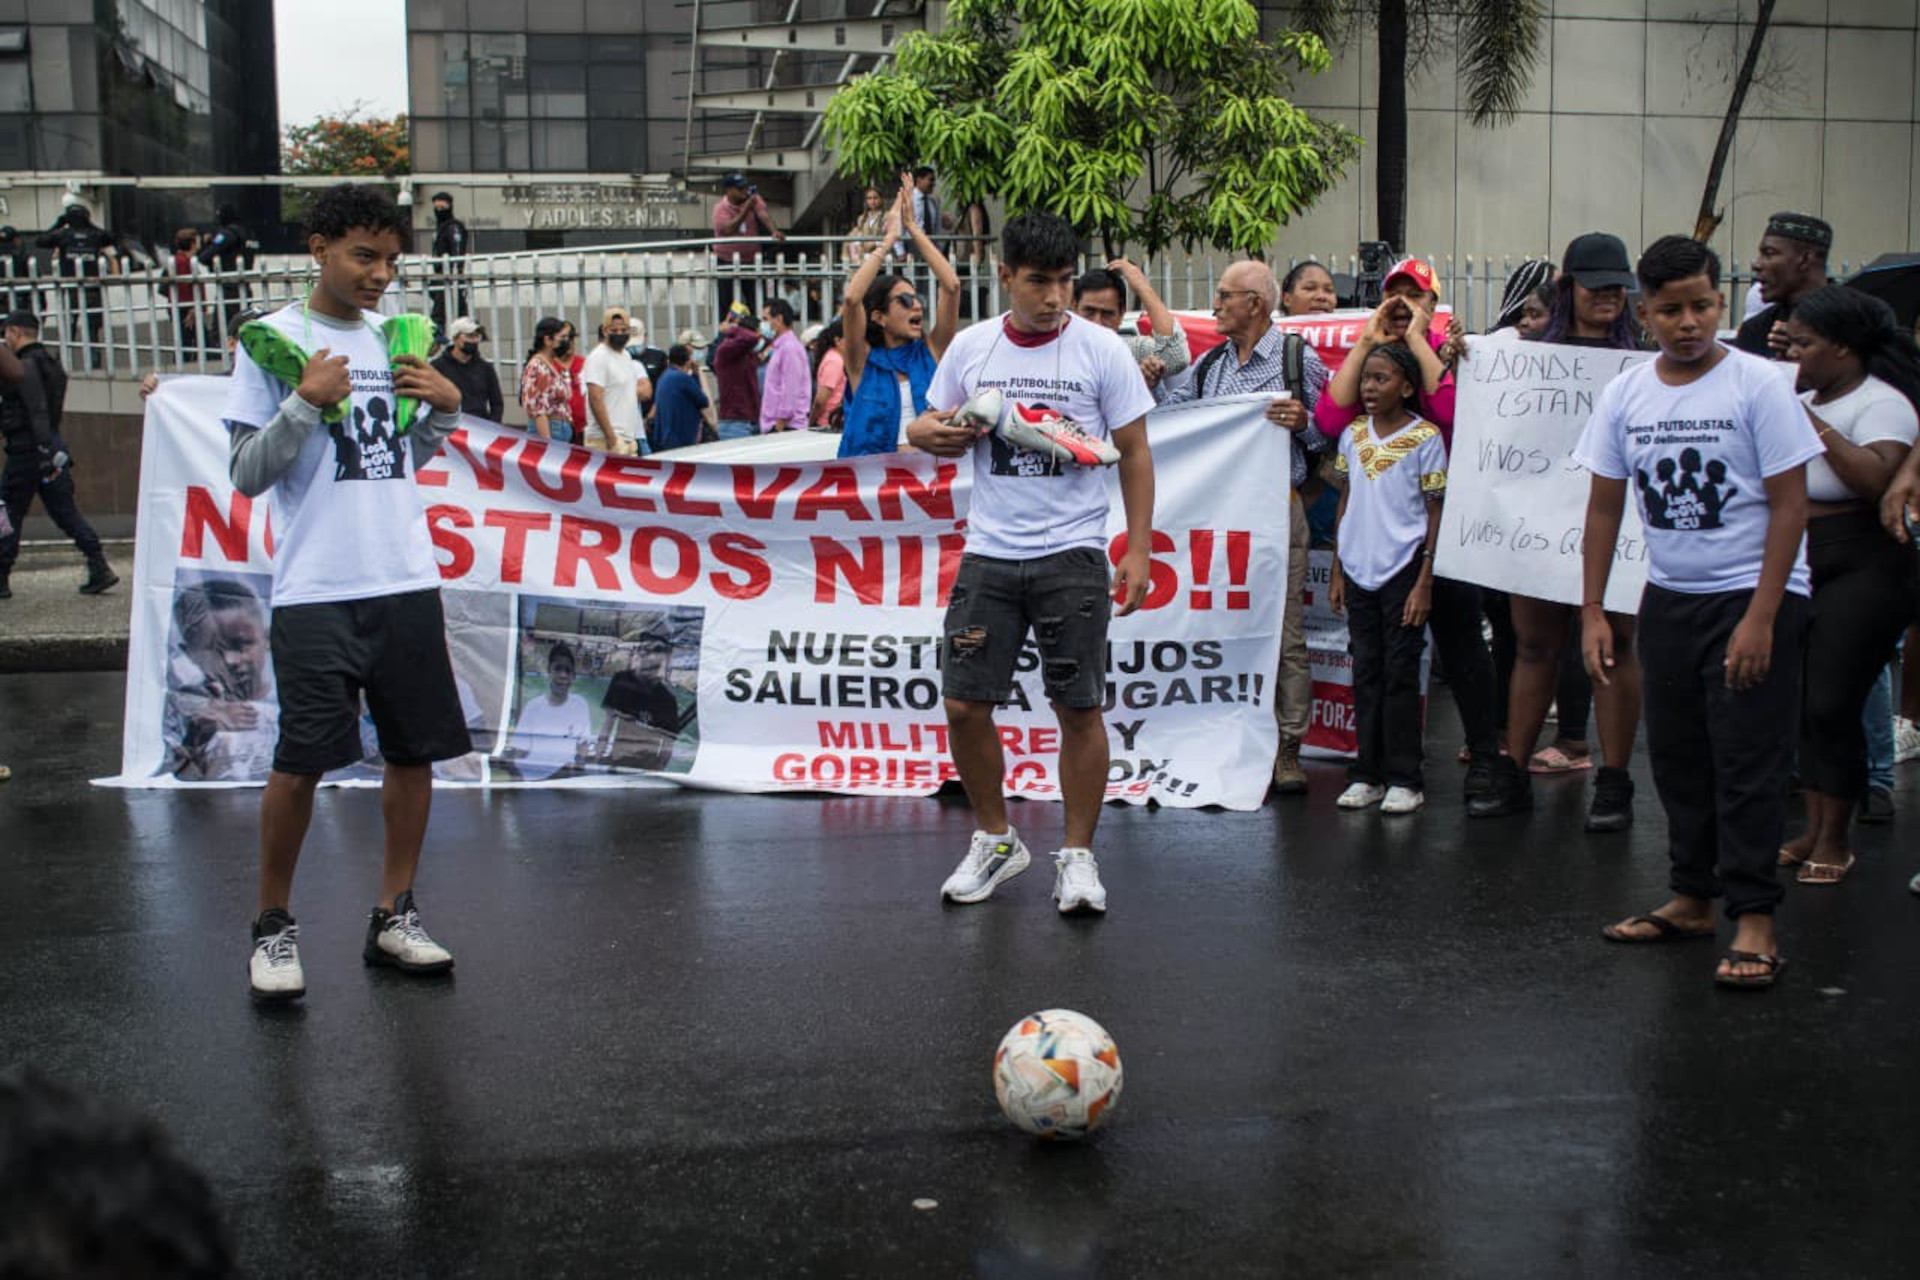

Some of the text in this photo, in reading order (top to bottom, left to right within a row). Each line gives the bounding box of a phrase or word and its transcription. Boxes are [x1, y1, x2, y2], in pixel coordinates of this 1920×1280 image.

[524, 209, 535, 226] Y
[724, 668, 939, 710] SALIERO
[817, 719, 1147, 755] MILITRE Y
